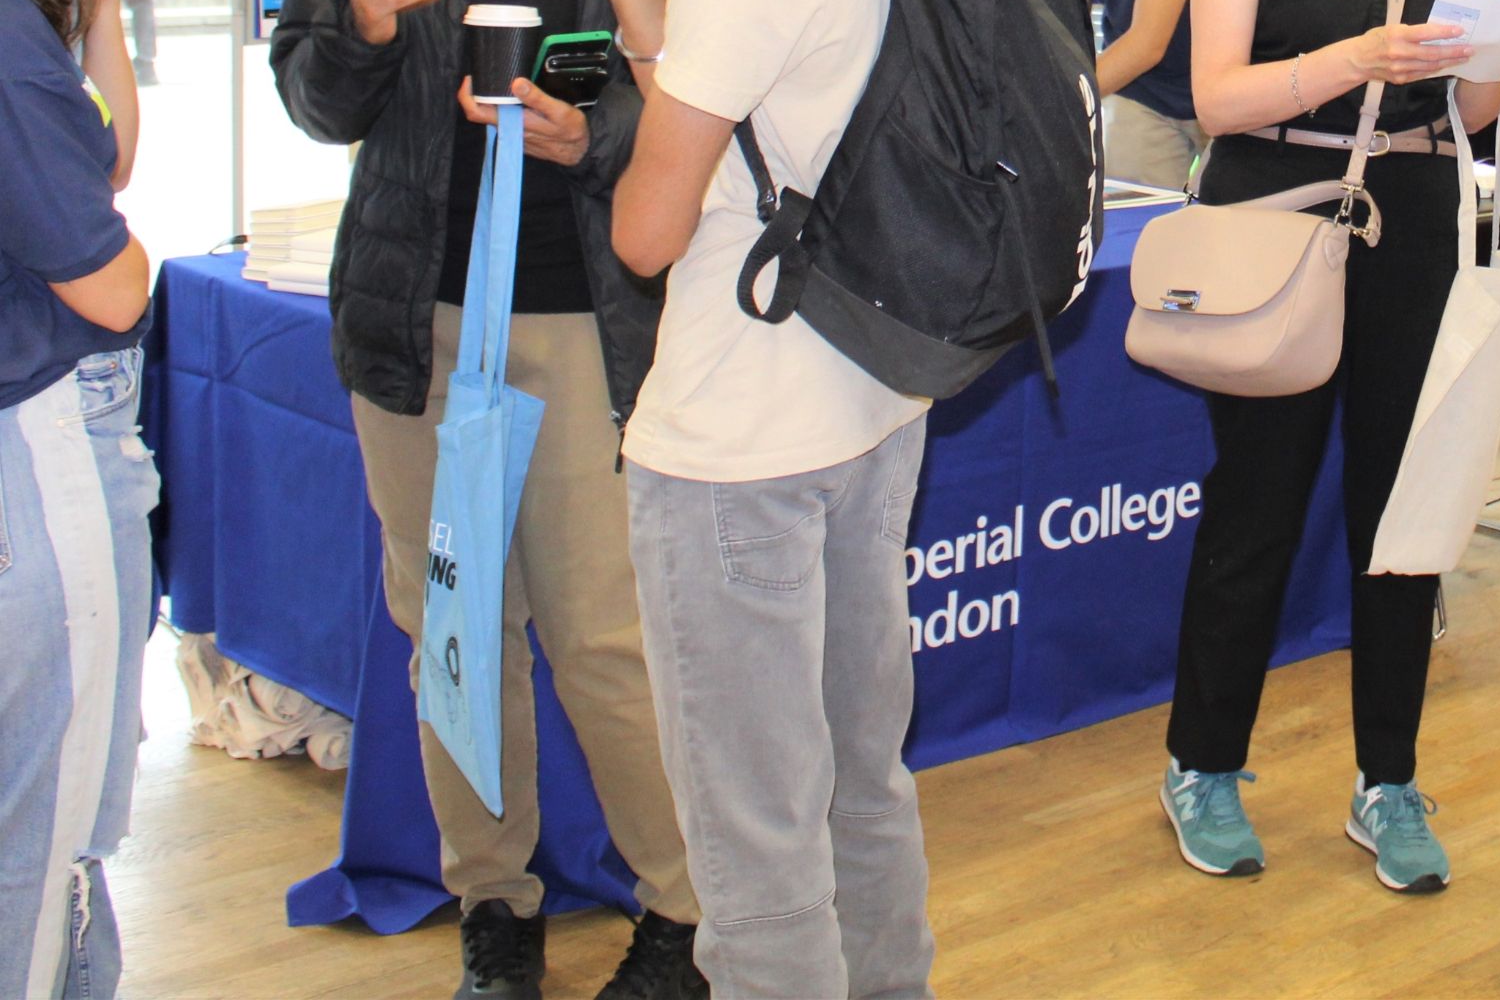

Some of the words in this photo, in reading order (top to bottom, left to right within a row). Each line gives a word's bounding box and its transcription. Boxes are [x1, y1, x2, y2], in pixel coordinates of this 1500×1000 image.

[905, 504, 1024, 587] perial
[1039, 481, 1201, 551] College
[909, 589, 1020, 654] ndon
